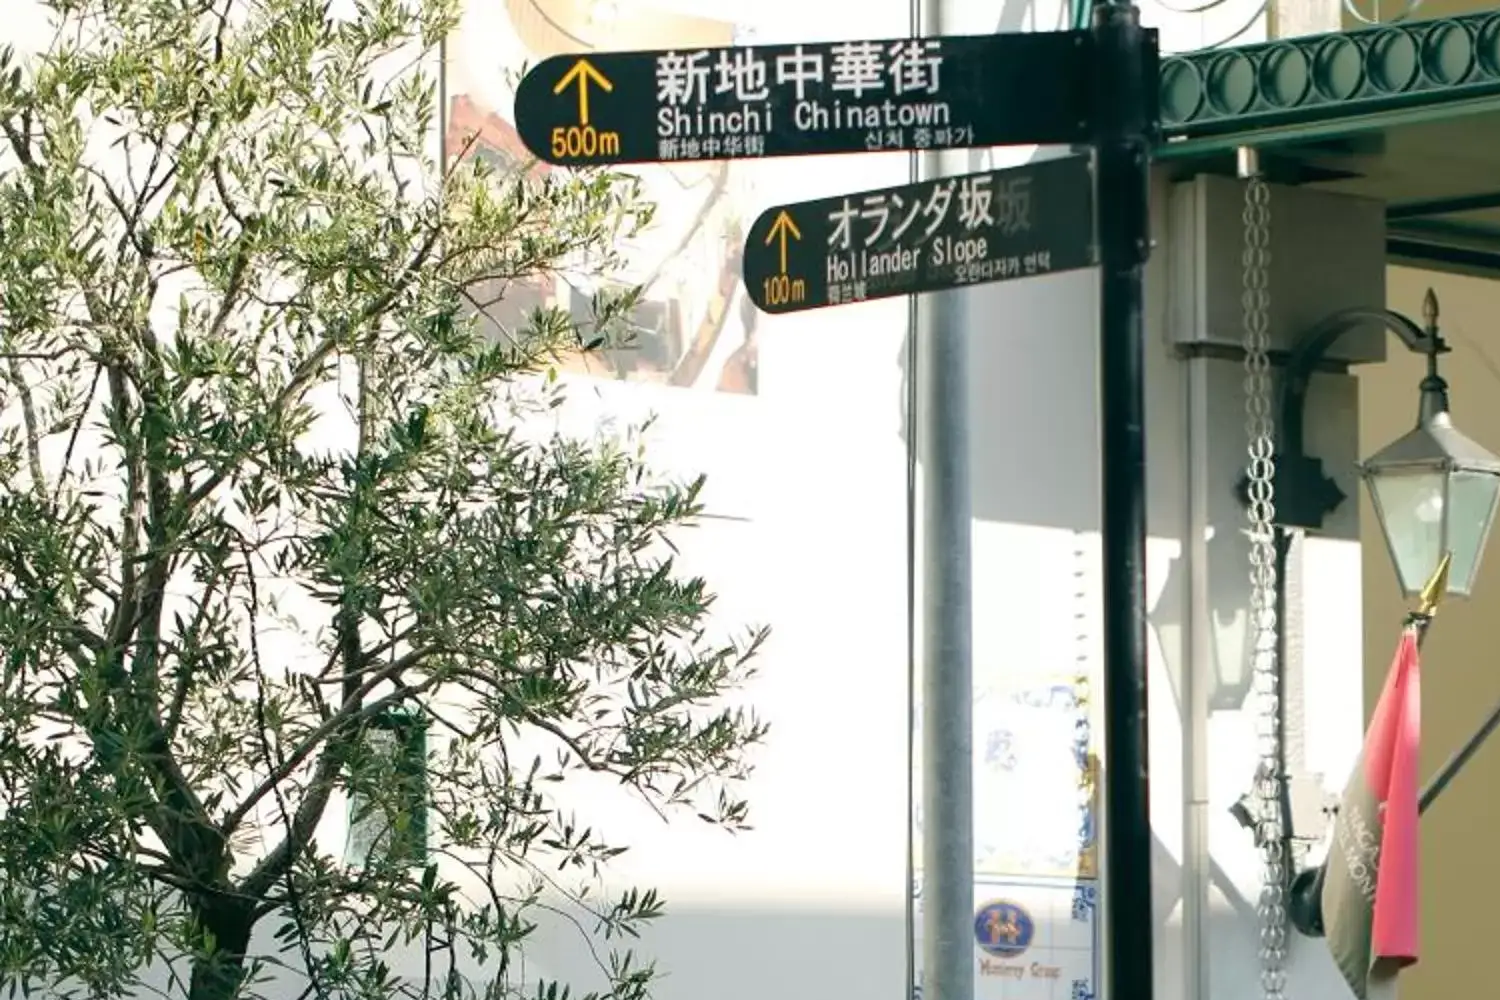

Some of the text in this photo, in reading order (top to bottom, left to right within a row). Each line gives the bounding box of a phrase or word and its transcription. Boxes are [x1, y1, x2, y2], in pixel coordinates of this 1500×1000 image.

[656, 41, 944, 106] 新地中華街
[657, 100, 950, 136] Shinchi Chinatown
[551, 126, 620, 159] 500m
[827, 175, 995, 250] オランダ坂
[826, 236, 988, 282] Hollander Slope
[763, 275, 805, 306] 100m
